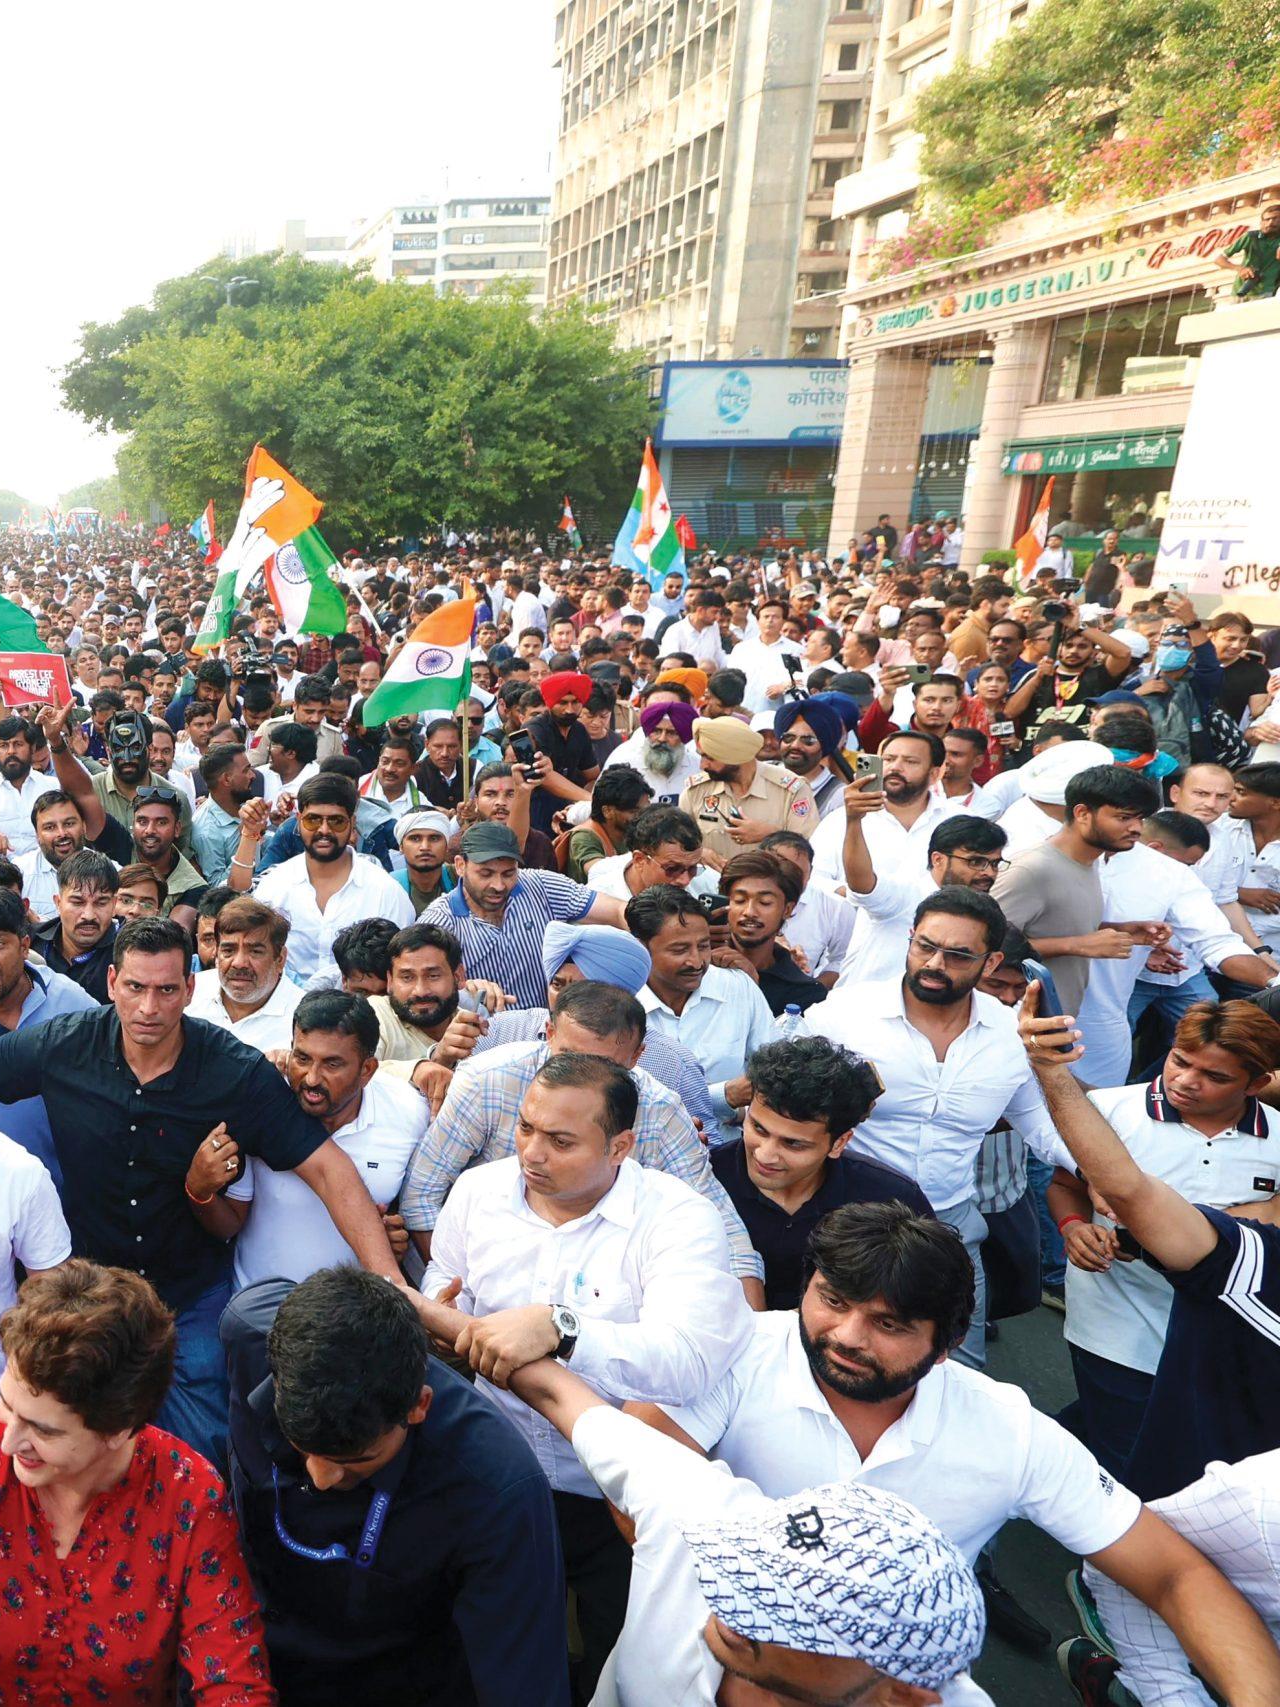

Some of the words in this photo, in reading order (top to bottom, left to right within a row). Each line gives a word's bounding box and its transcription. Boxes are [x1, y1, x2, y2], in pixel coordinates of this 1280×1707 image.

[961, 255, 1135, 313] JUGGERNAUT
[8, 669, 37, 680] ARREST
[369, 1494, 388, 1534] Security
[364, 1533, 375, 1547] VIP
